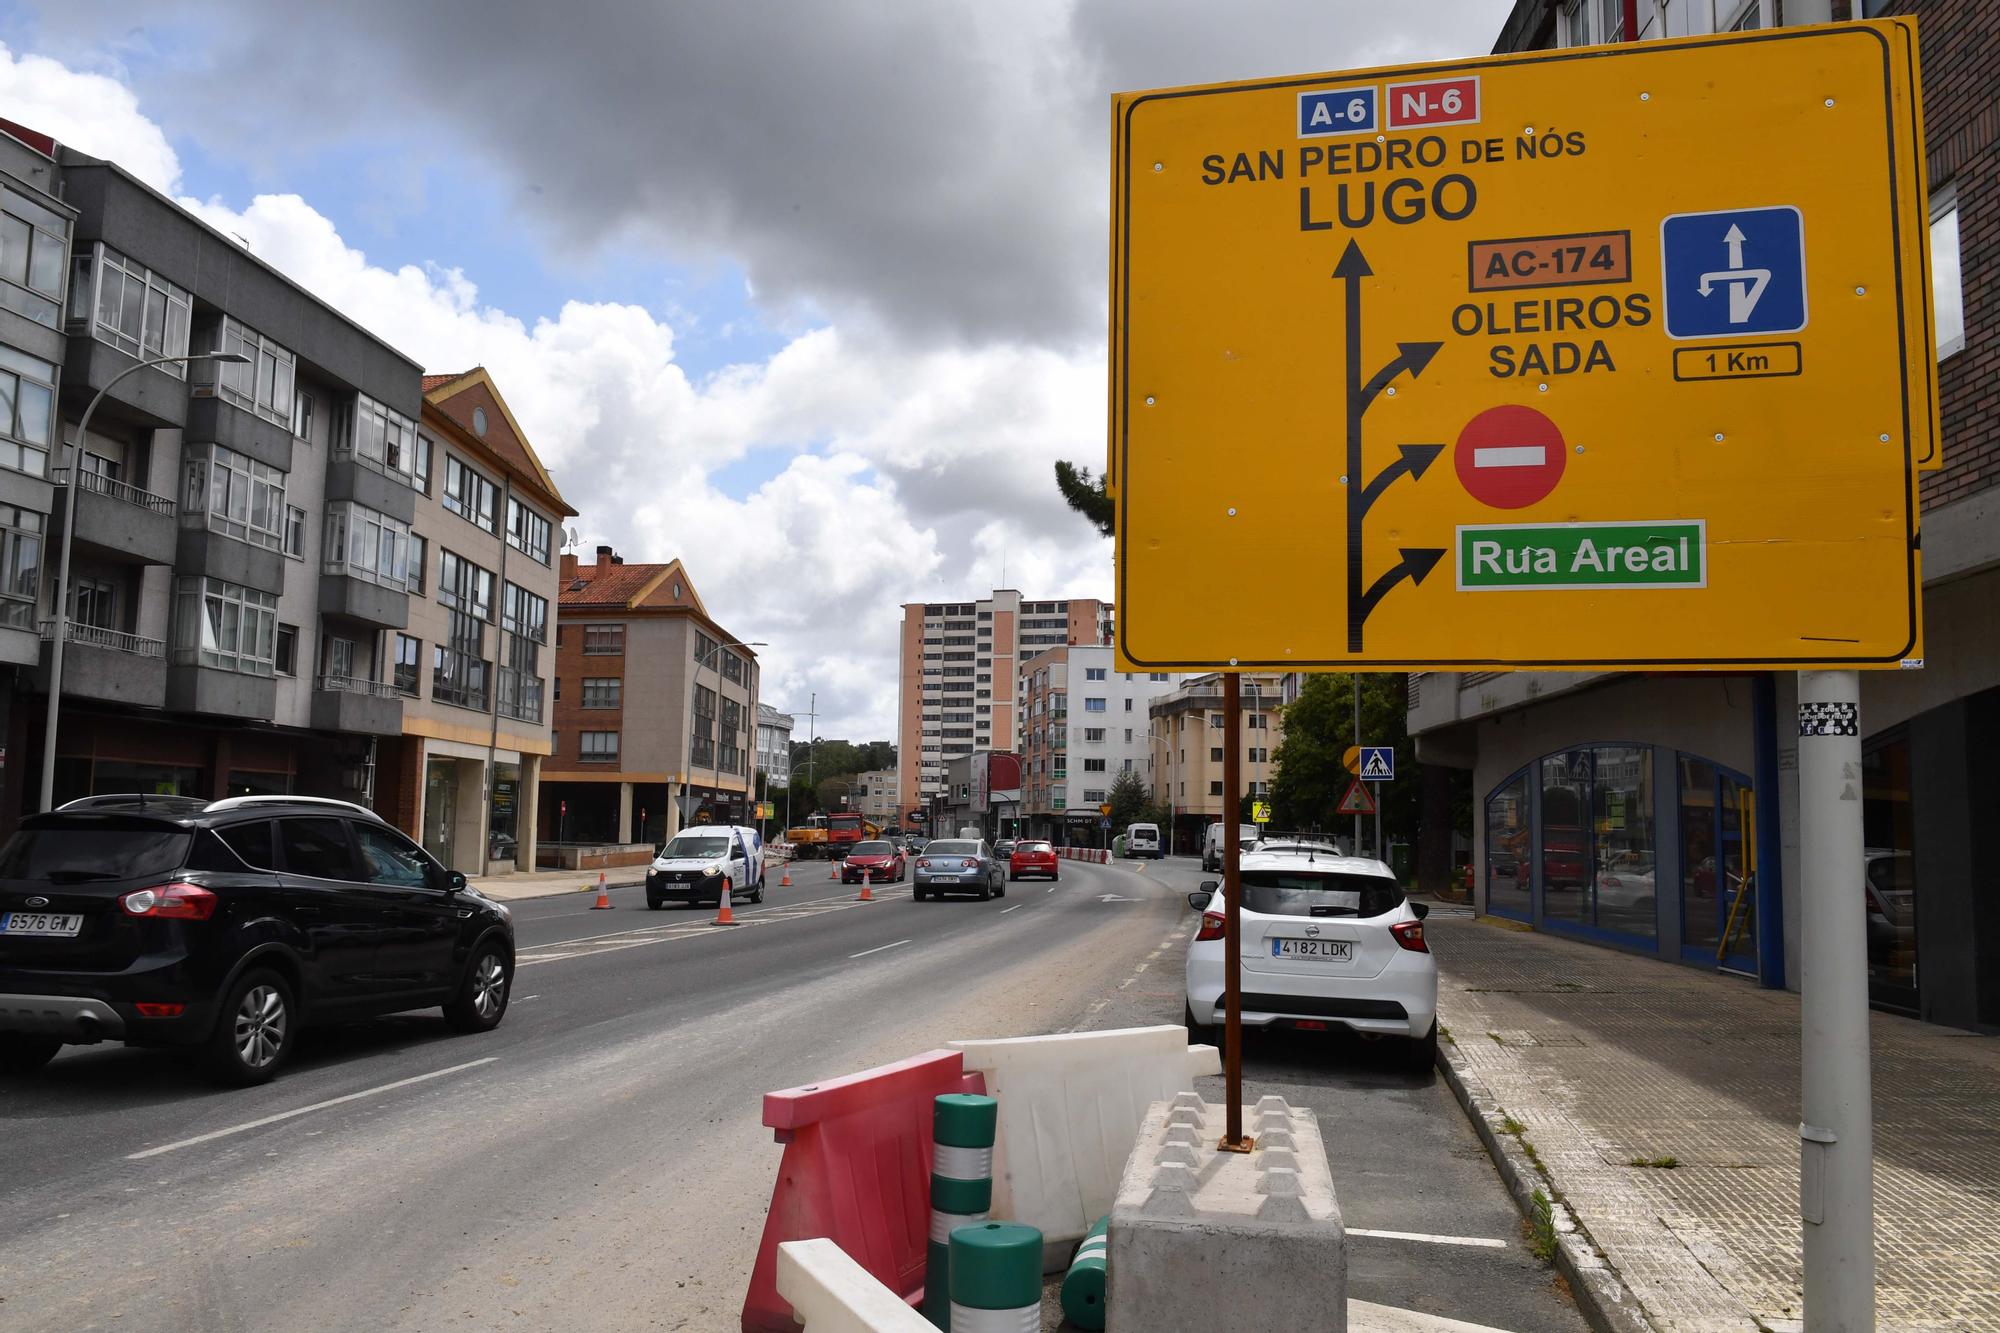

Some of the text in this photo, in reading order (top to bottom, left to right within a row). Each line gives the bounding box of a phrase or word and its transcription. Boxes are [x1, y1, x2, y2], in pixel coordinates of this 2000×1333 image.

[1310, 98, 1366, 126] A-6
[1402, 88, 1462, 118] N-6
[1201, 127, 1586, 186] SAN PEDRO DE NÓS
[1300, 173, 1477, 232] LUGO
[1485, 244, 1615, 280] AC-174
[1451, 293, 1652, 337] OLEIROS
[1489, 339, 1616, 378] SADA
[1706, 351, 1769, 373] 1 Km
[1570, 536, 1688, 573] Areal
[10, 915, 80, 931] 6576 GWJ
[1282, 941, 1348, 956] 4182 LDK
